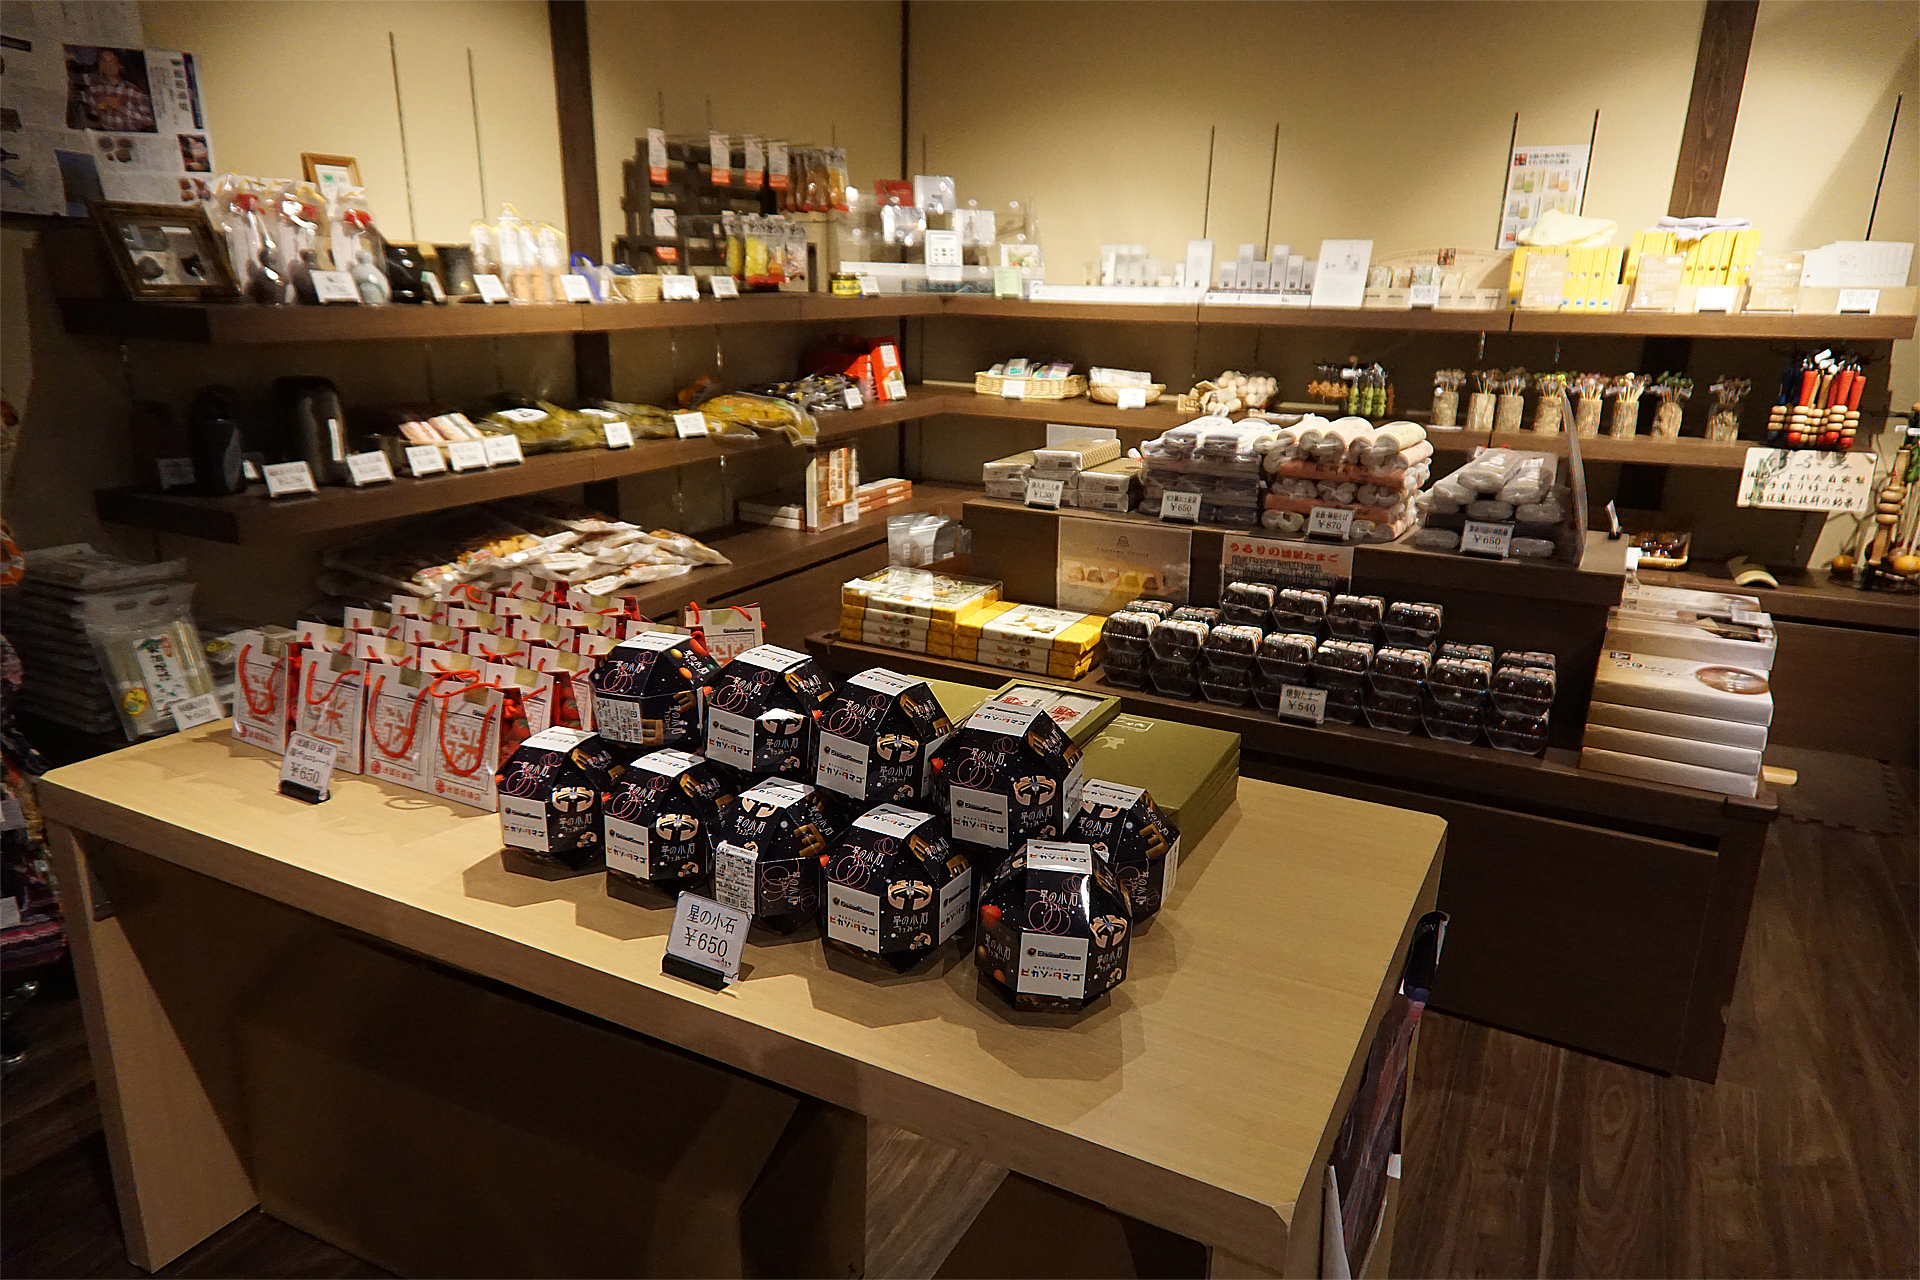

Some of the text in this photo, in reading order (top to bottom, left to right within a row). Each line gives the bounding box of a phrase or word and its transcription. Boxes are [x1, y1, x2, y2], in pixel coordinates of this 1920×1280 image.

[1288, 700, 1317, 713] ¥540
[290, 761, 320, 784] ¥650
[686, 904, 738, 935] 星の小石
[684, 926, 728, 958] ¥650
